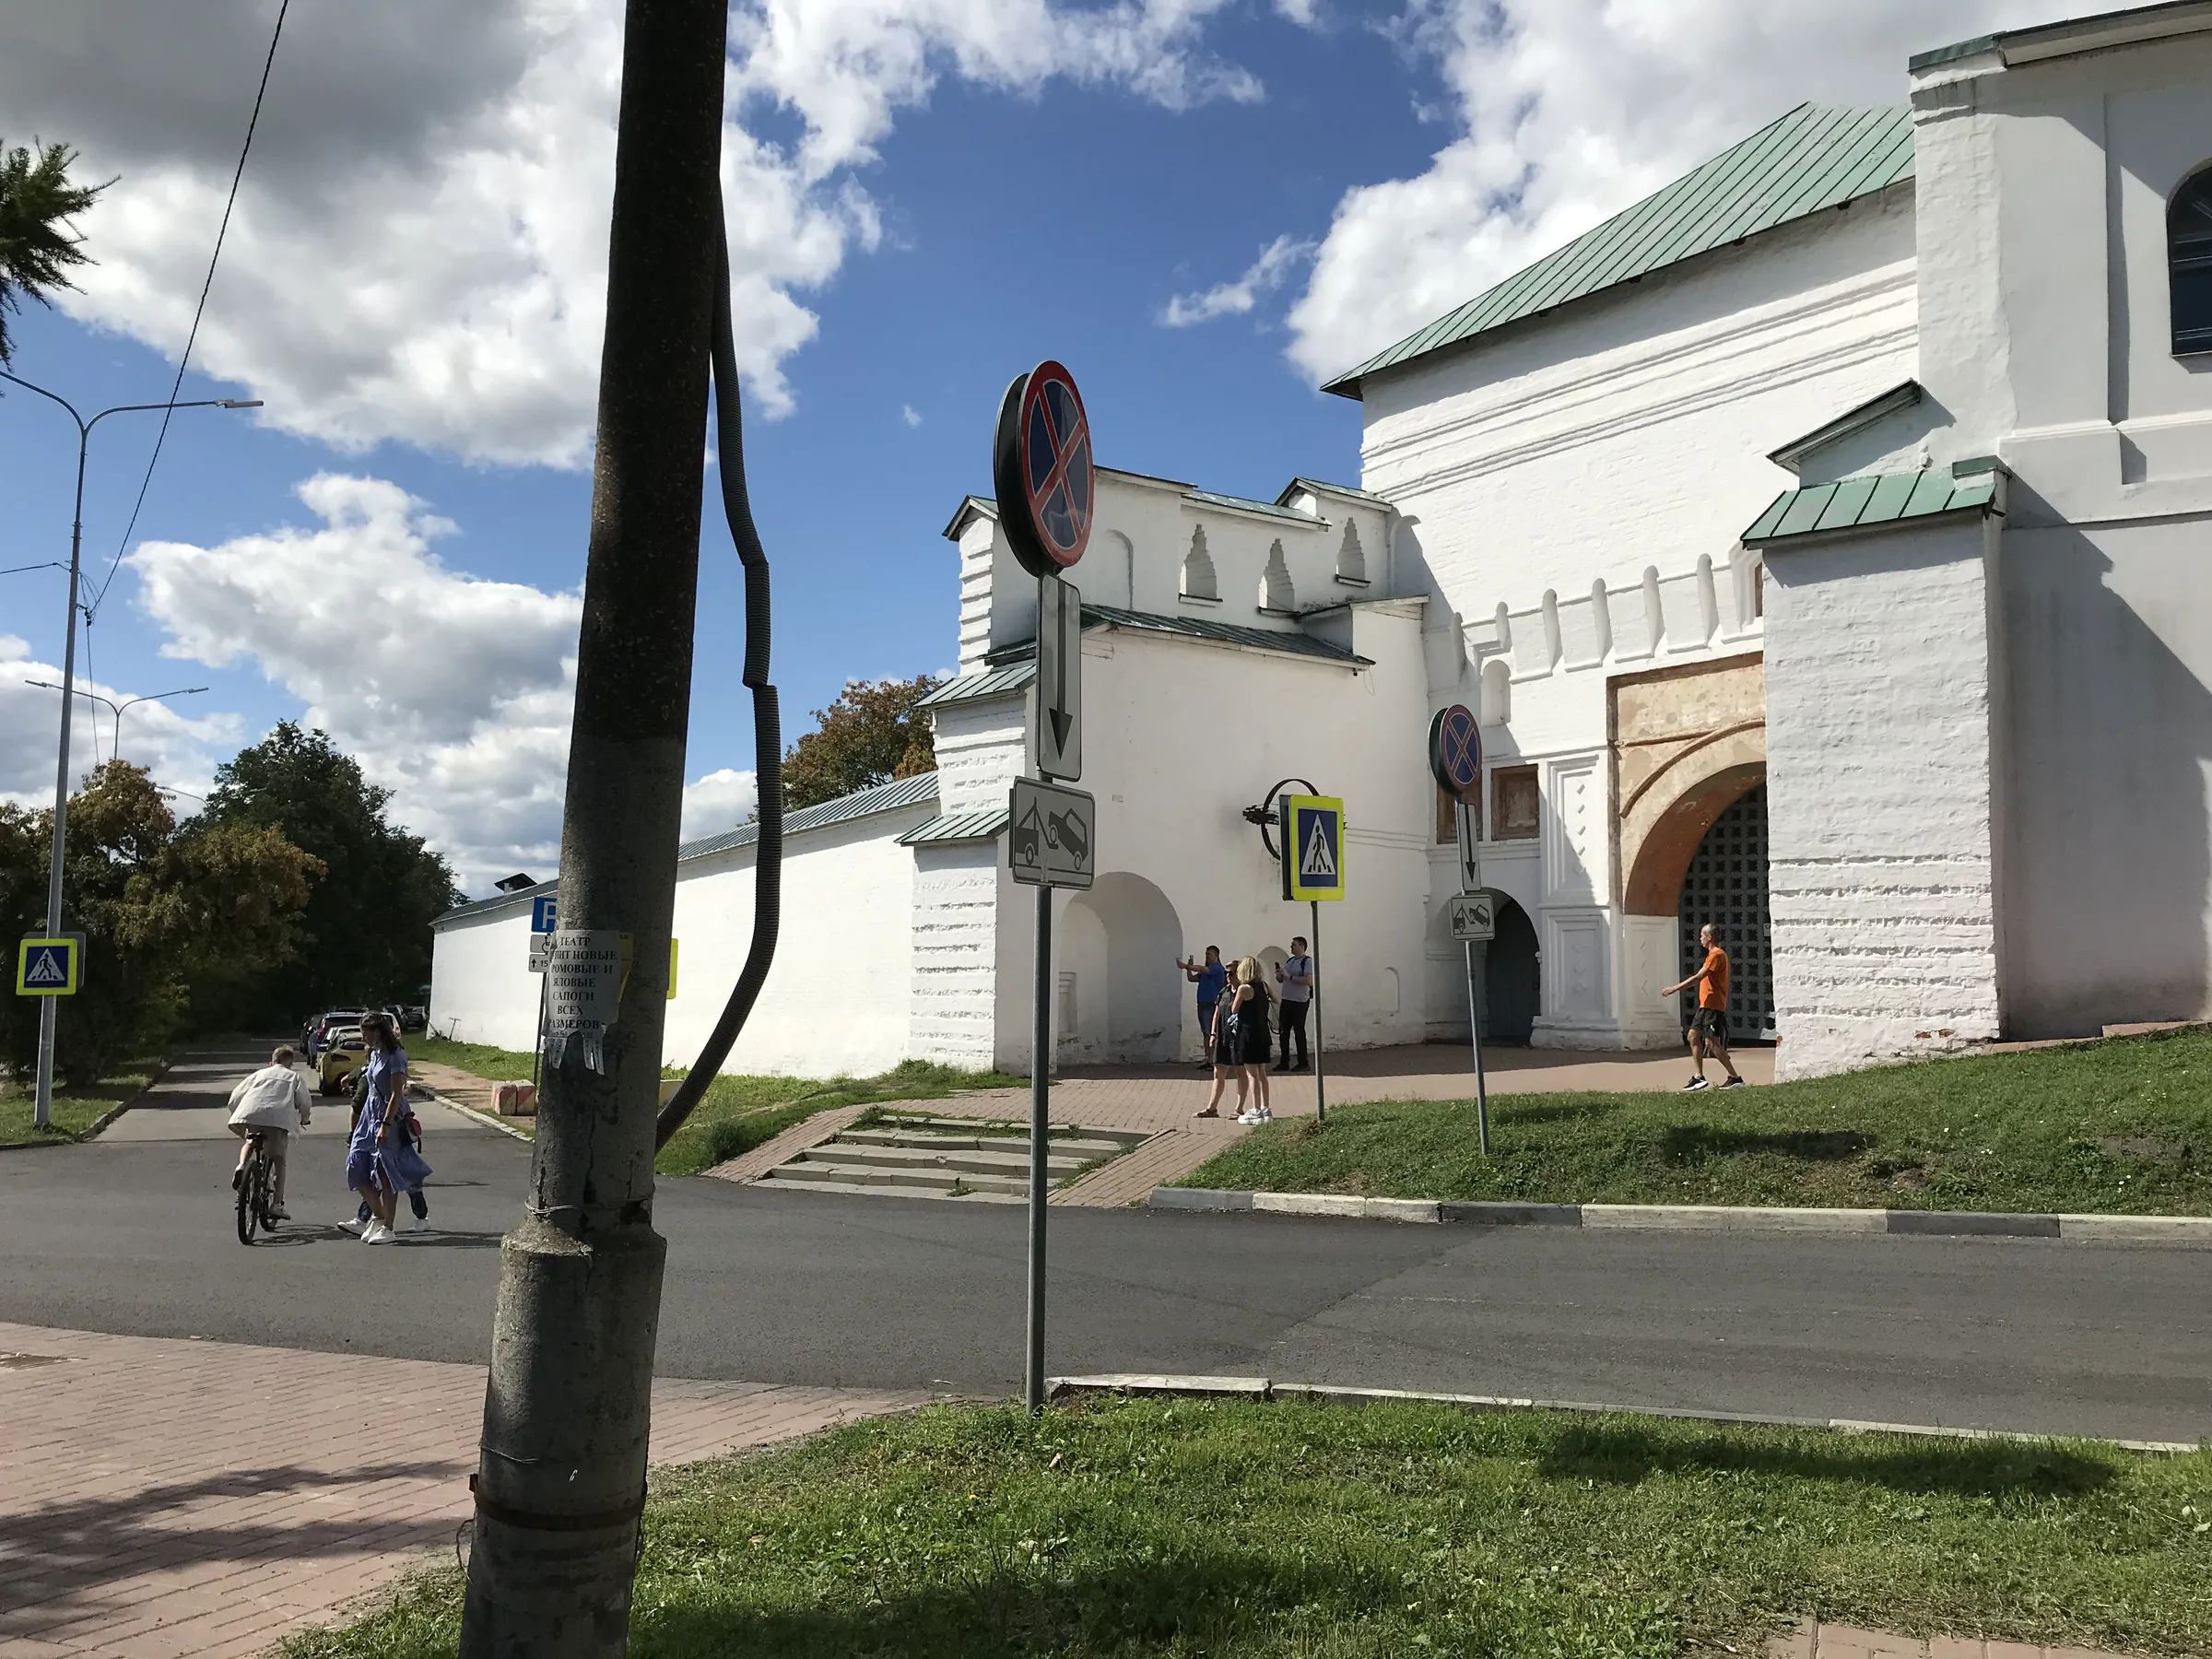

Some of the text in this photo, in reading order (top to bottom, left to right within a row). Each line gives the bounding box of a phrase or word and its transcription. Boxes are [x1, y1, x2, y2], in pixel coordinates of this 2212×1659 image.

[560, 937, 591, 947] ТЕАТР
[572, 950, 618, 960] НОВЫЕ
[551, 963, 614, 974] РОМОВЫЕ И
[553, 977, 596, 987] ЯЛОВЫЕ
[552, 991, 594, 1001] САПОГИ
[557, 1005, 583, 1015] ВСЕХ
